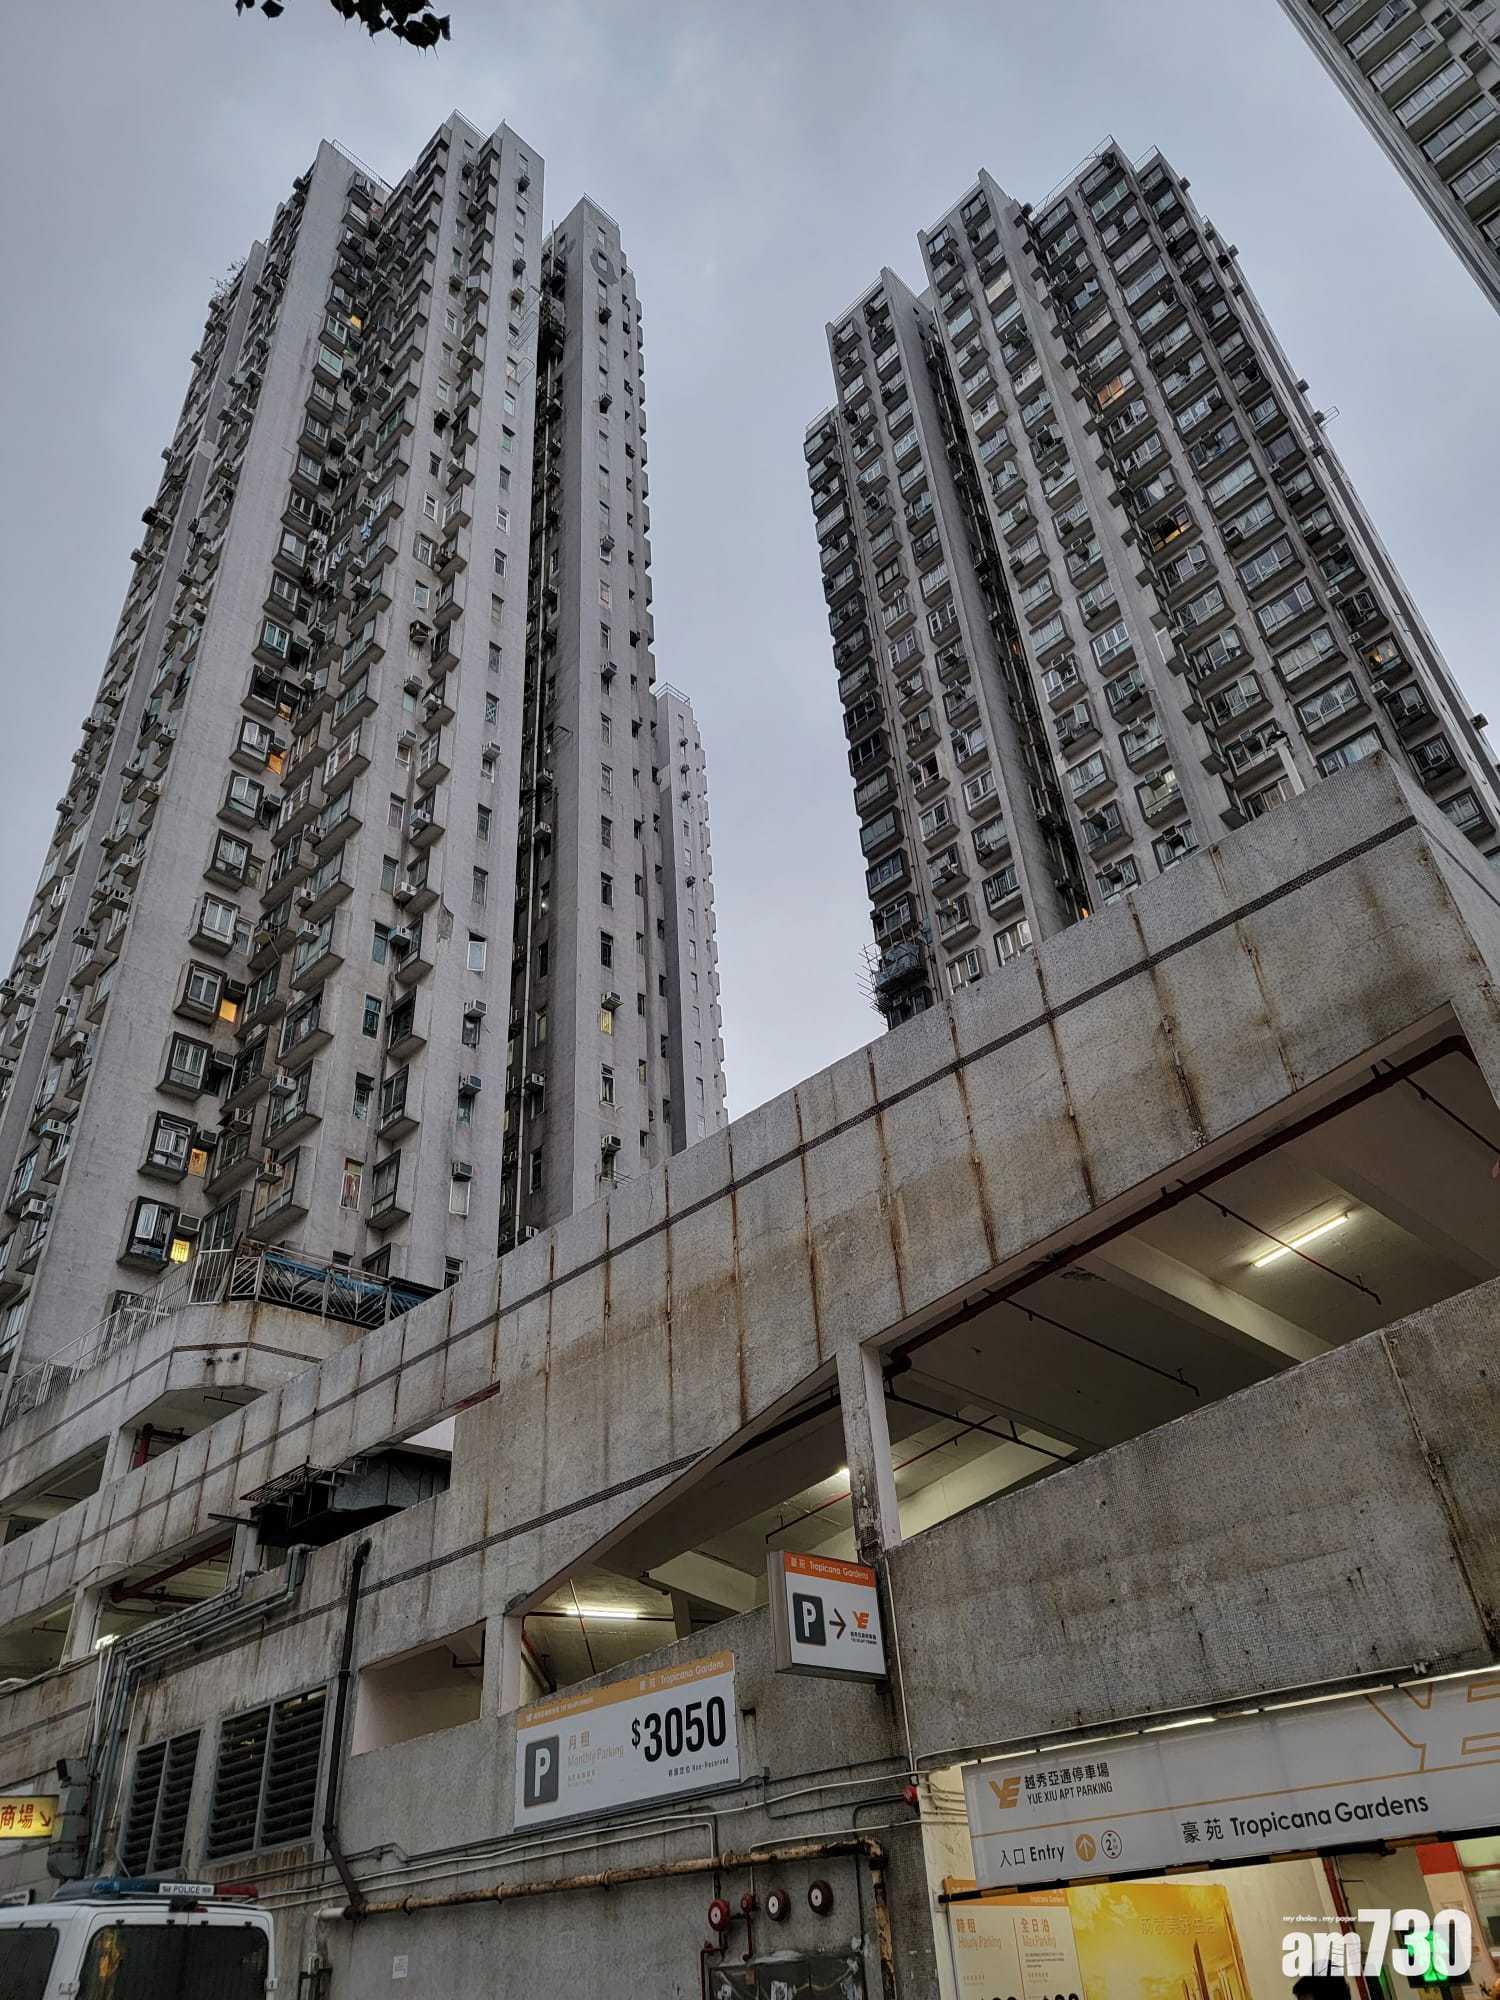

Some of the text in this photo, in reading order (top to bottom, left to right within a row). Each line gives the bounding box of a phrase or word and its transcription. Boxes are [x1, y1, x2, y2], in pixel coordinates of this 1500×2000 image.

[802, 1601, 817, 1638] P
[631, 1696, 727, 1763] $3050
[534, 1748, 551, 1797] P
[1024, 1762, 1110, 1790] 越秀亞通停車場
[1027, 1782, 1113, 1806] YUE XIU APT PARKING
[0, 1804, 34, 1830] 商場
[1181, 1795, 1429, 1844] 豪苑 Tropicana Gardens
[1000, 1844, 1065, 1868] 入口 Entry
[174, 1885, 201, 1895] POLICE
